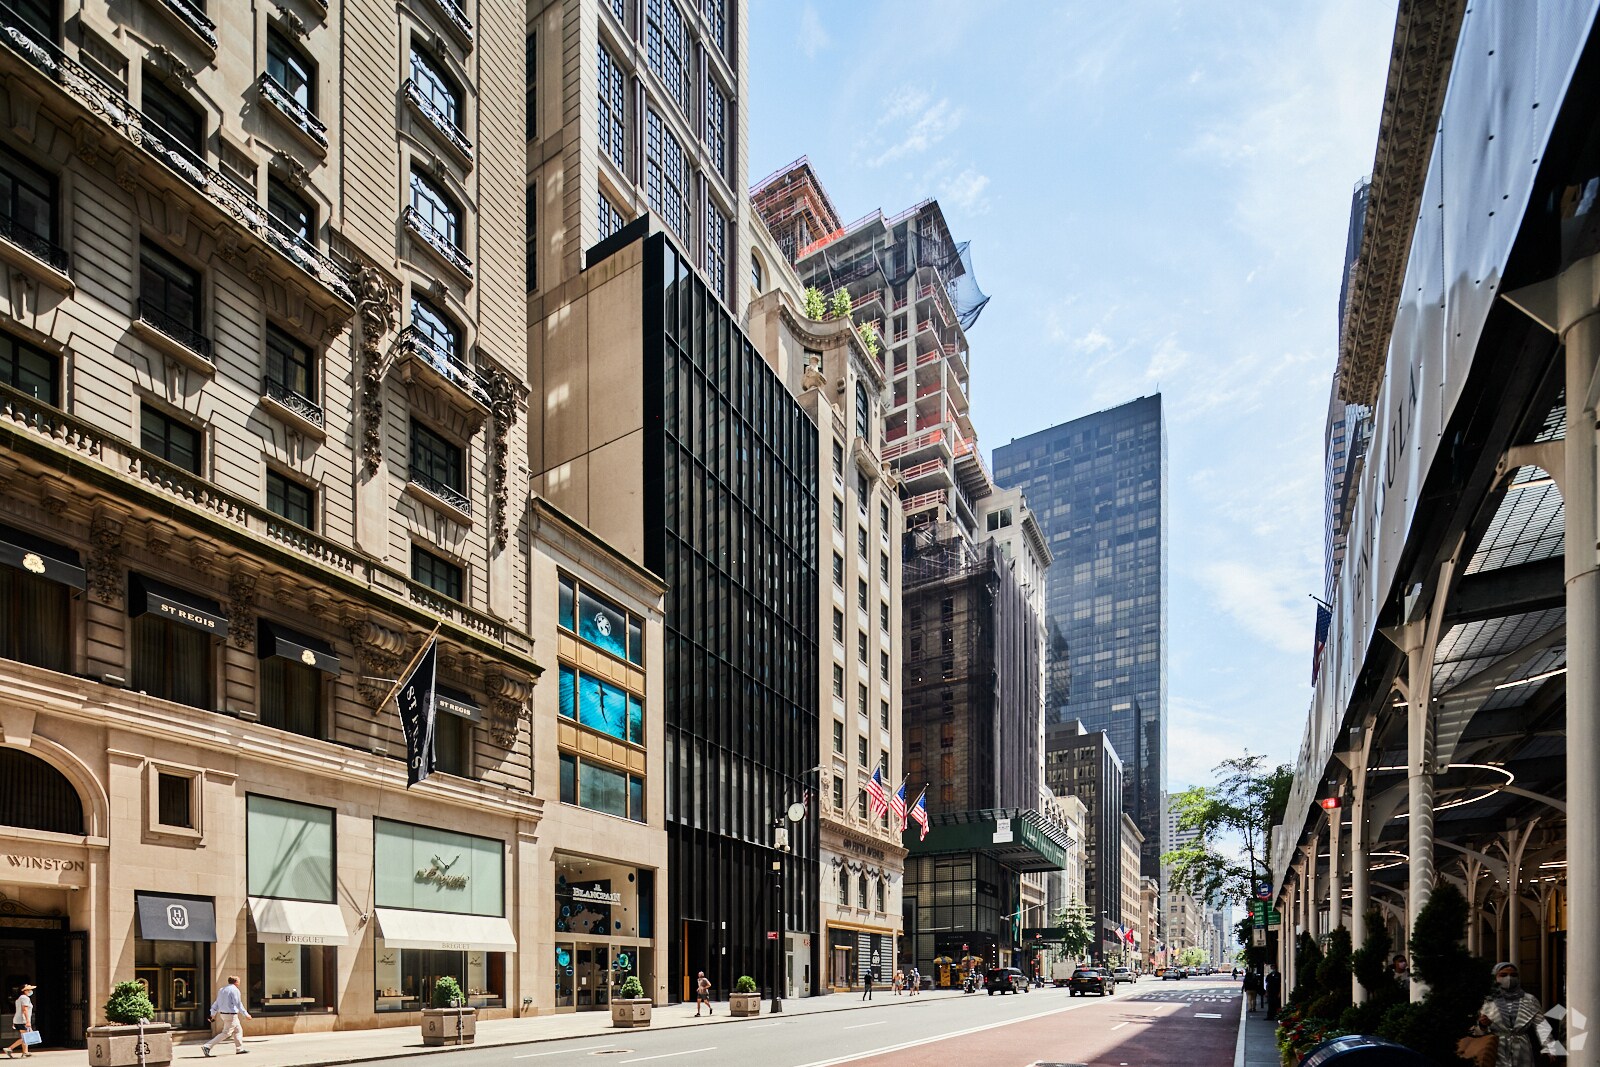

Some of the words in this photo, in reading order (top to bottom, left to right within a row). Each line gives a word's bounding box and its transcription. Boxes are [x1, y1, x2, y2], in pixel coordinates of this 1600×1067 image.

[161, 603, 176, 615] ST
[178, 609, 215, 628] REGIS
[439, 700, 449, 710] ST
[449, 704, 471, 716] REGIS
[7, 855, 85, 871] WINSTON
[572, 887, 621, 901] BLANCPAIN
[285, 935, 325, 944] BREGUET
[441, 942, 471, 950] BREGUET
